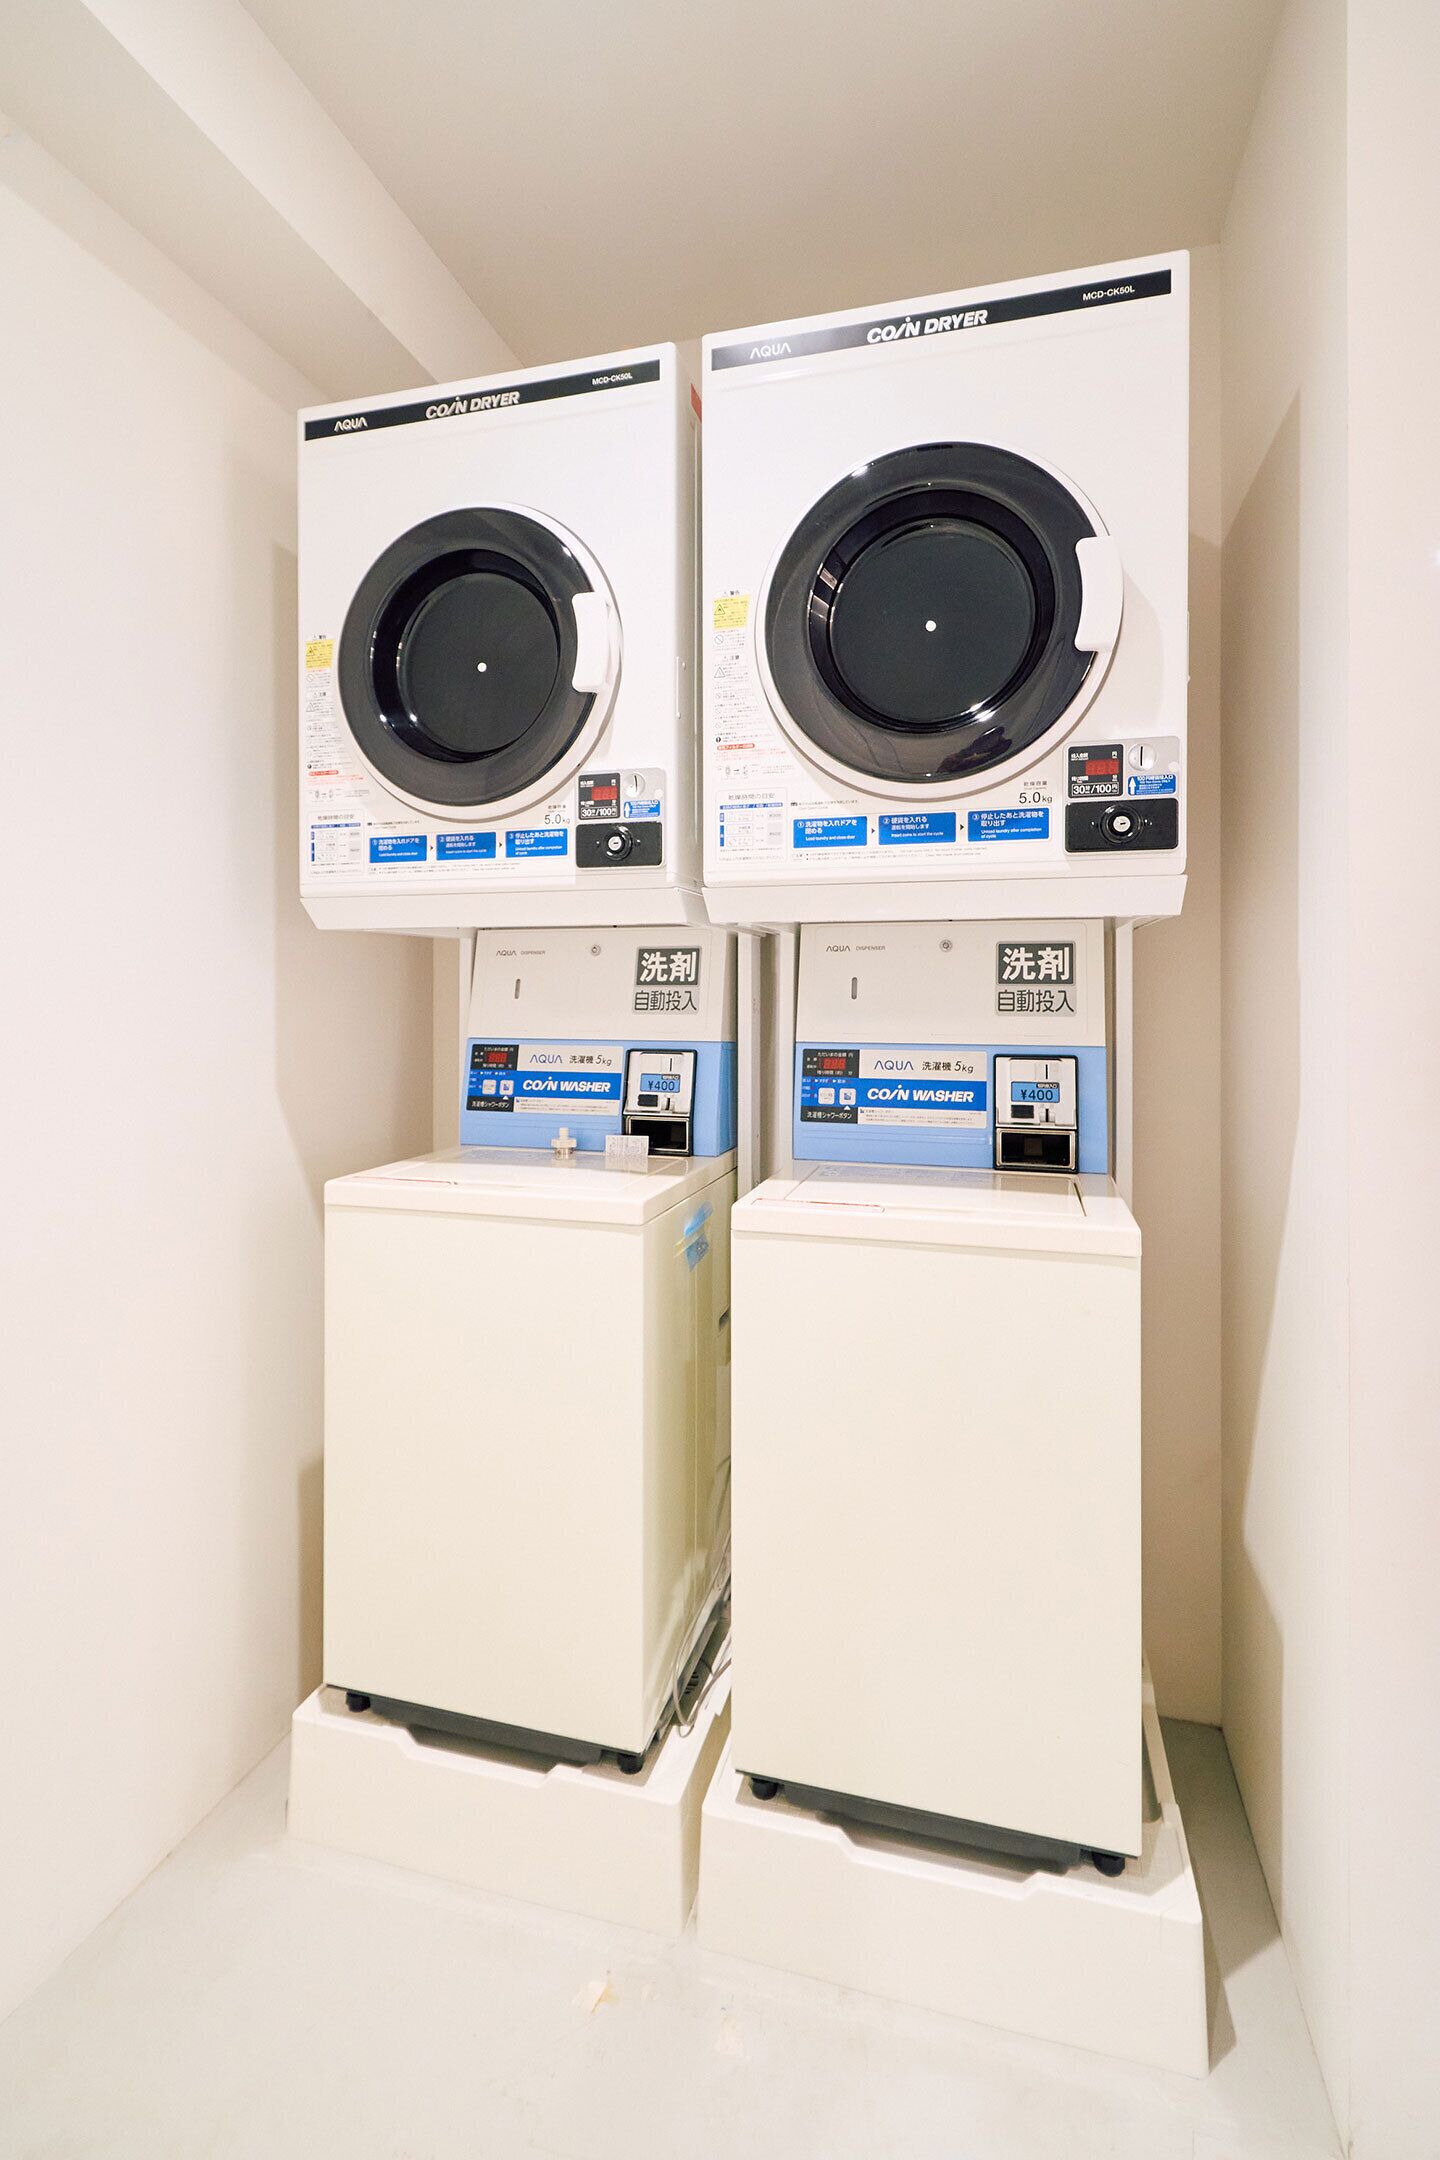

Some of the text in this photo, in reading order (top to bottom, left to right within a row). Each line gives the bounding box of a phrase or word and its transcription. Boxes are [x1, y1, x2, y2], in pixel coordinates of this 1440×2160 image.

[1082, 284, 1136, 302] MCD-CK50L
[924, 309, 989, 334] DRYER
[749, 342, 792, 360] AQUA
[591, 372, 633, 387] MCD-CK50L
[469, 391, 521, 412] DRYER
[333, 416, 369, 432] AQUA
[639, 950, 698, 982] 洗剤
[1002, 946, 1070, 981] 洗剤
[634, 990, 698, 1011] 自動投入
[997, 990, 1075, 1012] 自動投入
[530, 1054, 562, 1064] AQUA
[569, 1056, 594, 1064] 洗濯機
[874, 1060, 914, 1071] AQUA
[922, 1062, 952, 1071] 洗濯機
[560, 1082, 611, 1092] WASHER
[648, 1080, 675, 1090] ¥400
[913, 1090, 974, 1102] WASHER
[1020, 1089, 1054, 1100] ¥400
